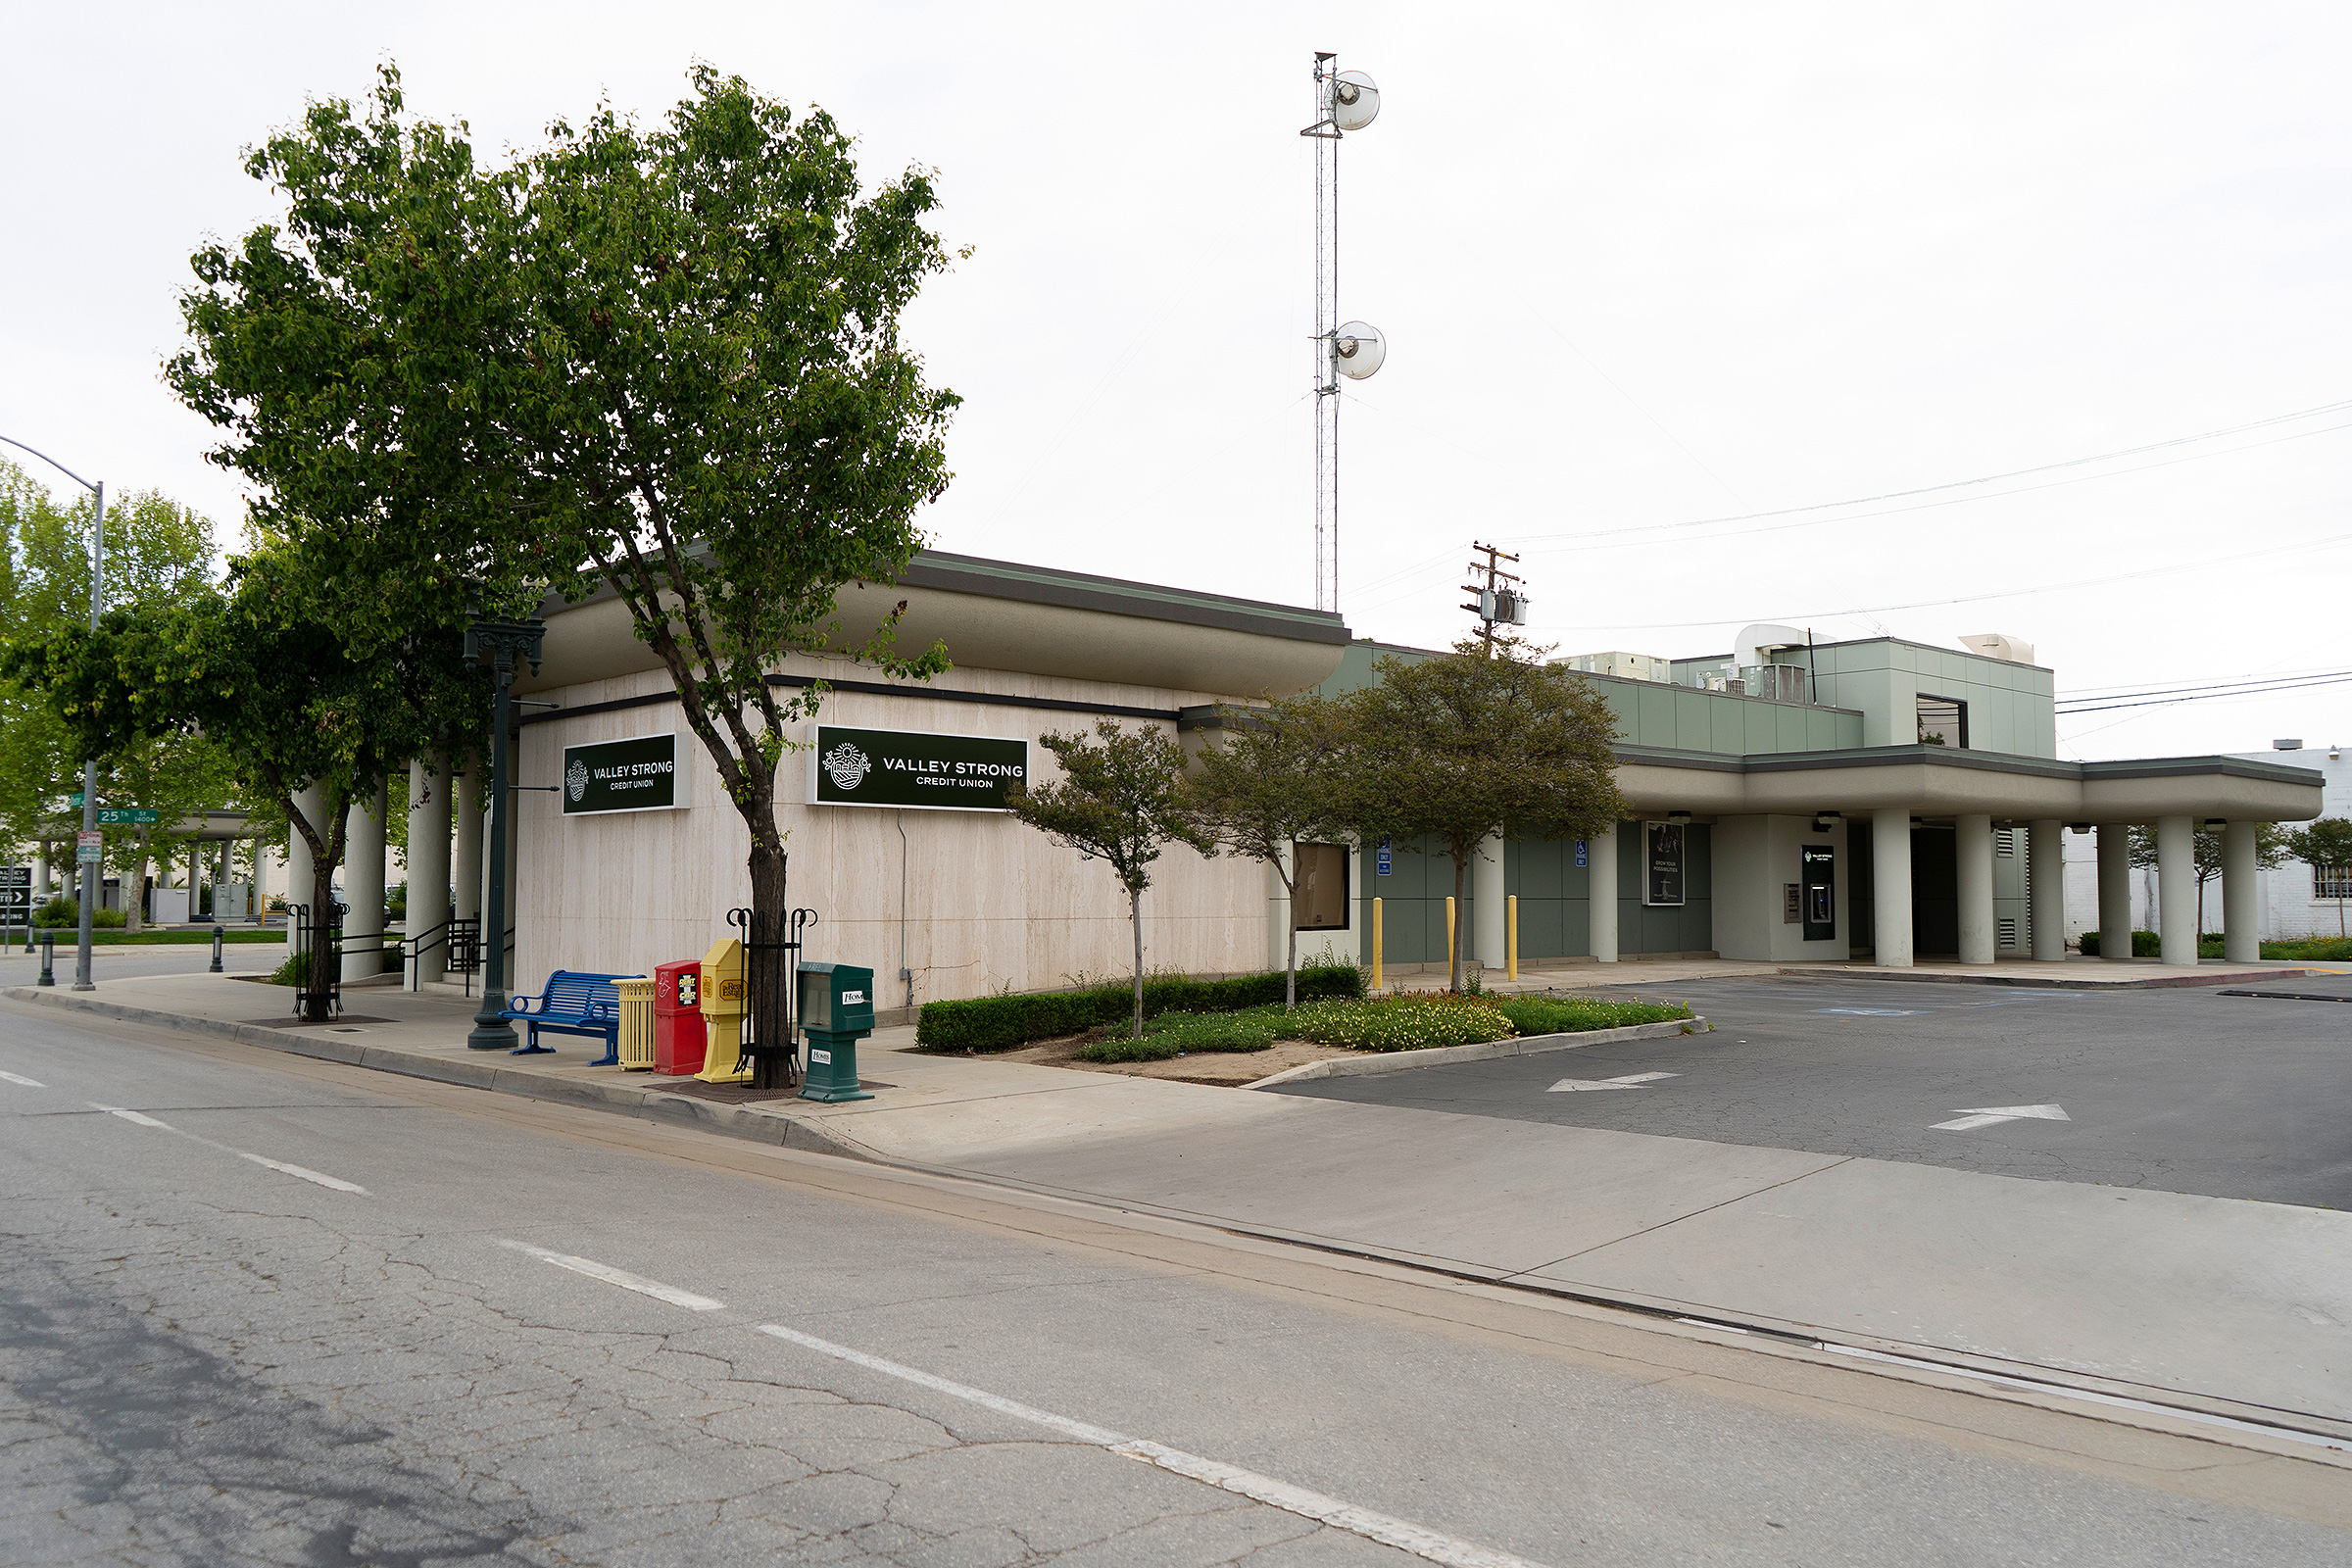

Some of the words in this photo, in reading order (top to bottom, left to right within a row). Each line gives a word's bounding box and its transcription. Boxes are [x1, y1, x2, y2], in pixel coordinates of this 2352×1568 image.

[594, 765, 629, 779] VALLEY
[631, 760, 673, 776] STRONG
[883, 758, 951, 773] VALLEY
[956, 761, 1023, 777] STRONG
[610, 781, 633, 791] CREDIT
[633, 779, 654, 789] UNION
[916, 776, 956, 787] CREDIT
[958, 778, 993, 789] UNION
[101, 811, 119, 821] 25
